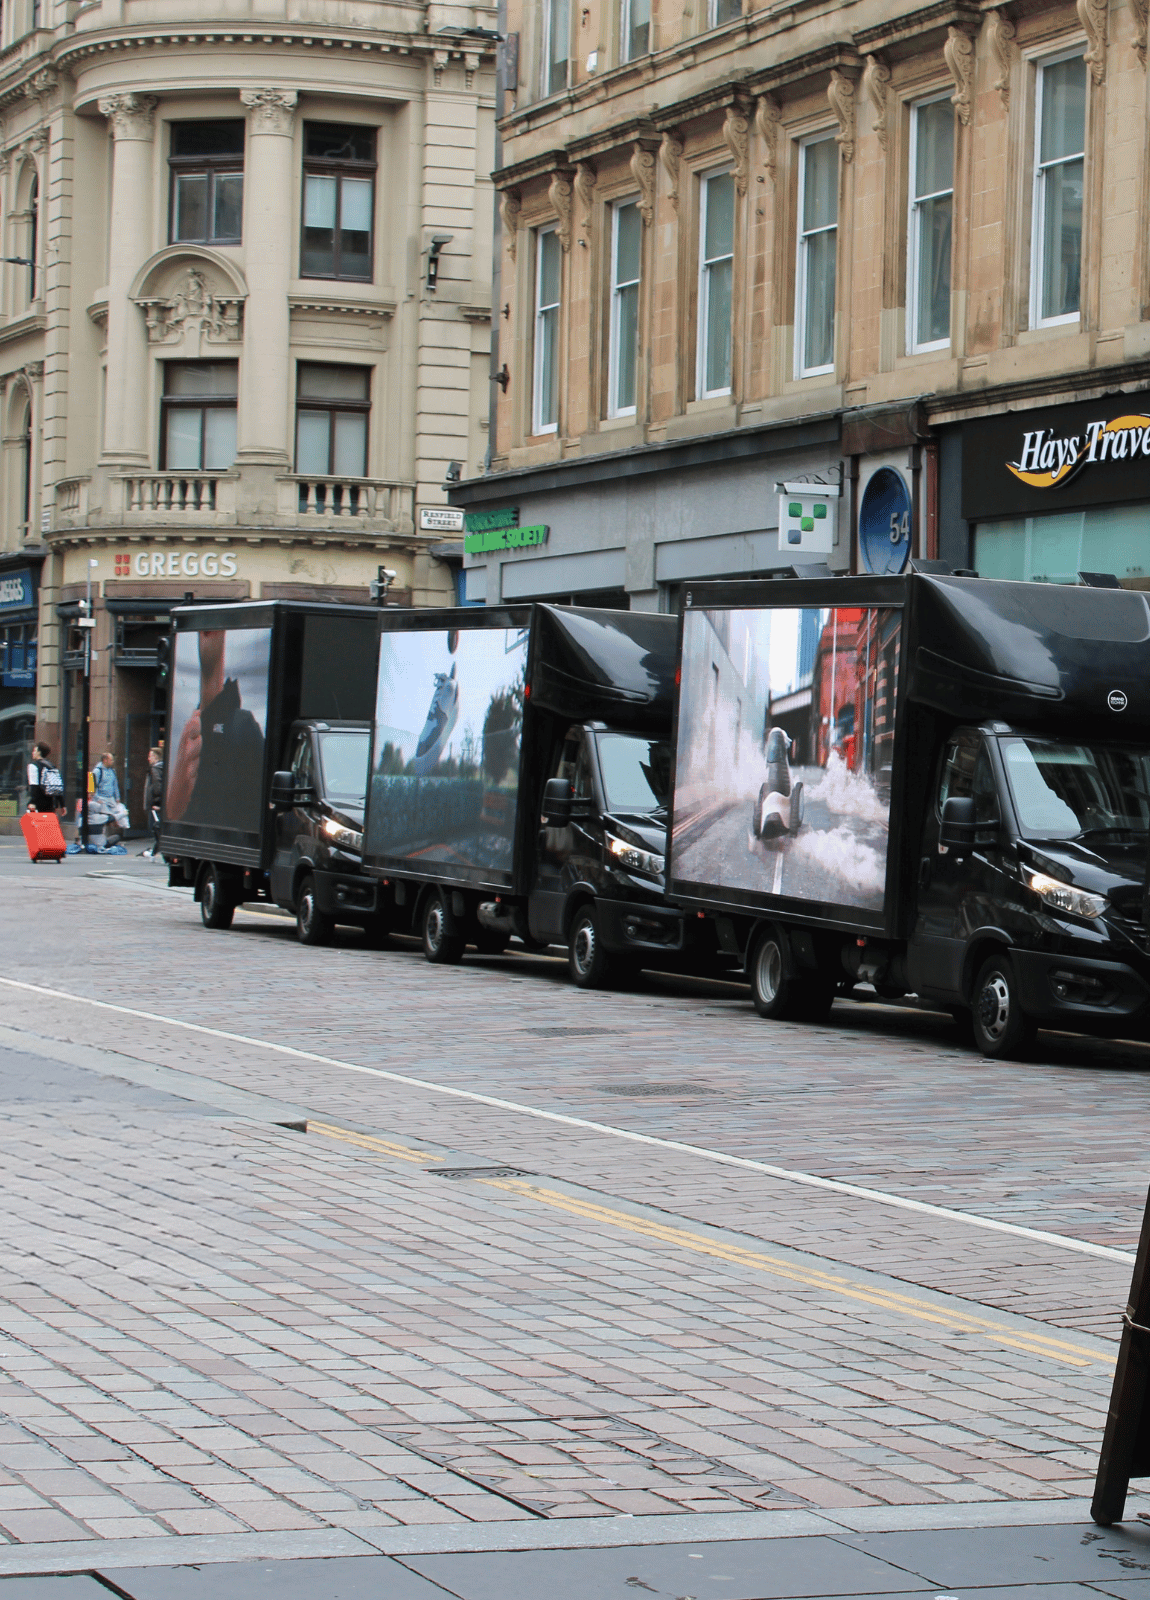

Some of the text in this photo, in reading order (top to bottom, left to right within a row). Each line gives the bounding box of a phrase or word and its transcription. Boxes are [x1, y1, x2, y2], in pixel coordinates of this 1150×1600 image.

[1018, 429, 1080, 479] Hays
[423, 510, 461, 519] RENFIELD
[427, 517, 457, 526] STREET
[889, 510, 910, 543] 54
[134, 551, 238, 577] GREGGS
